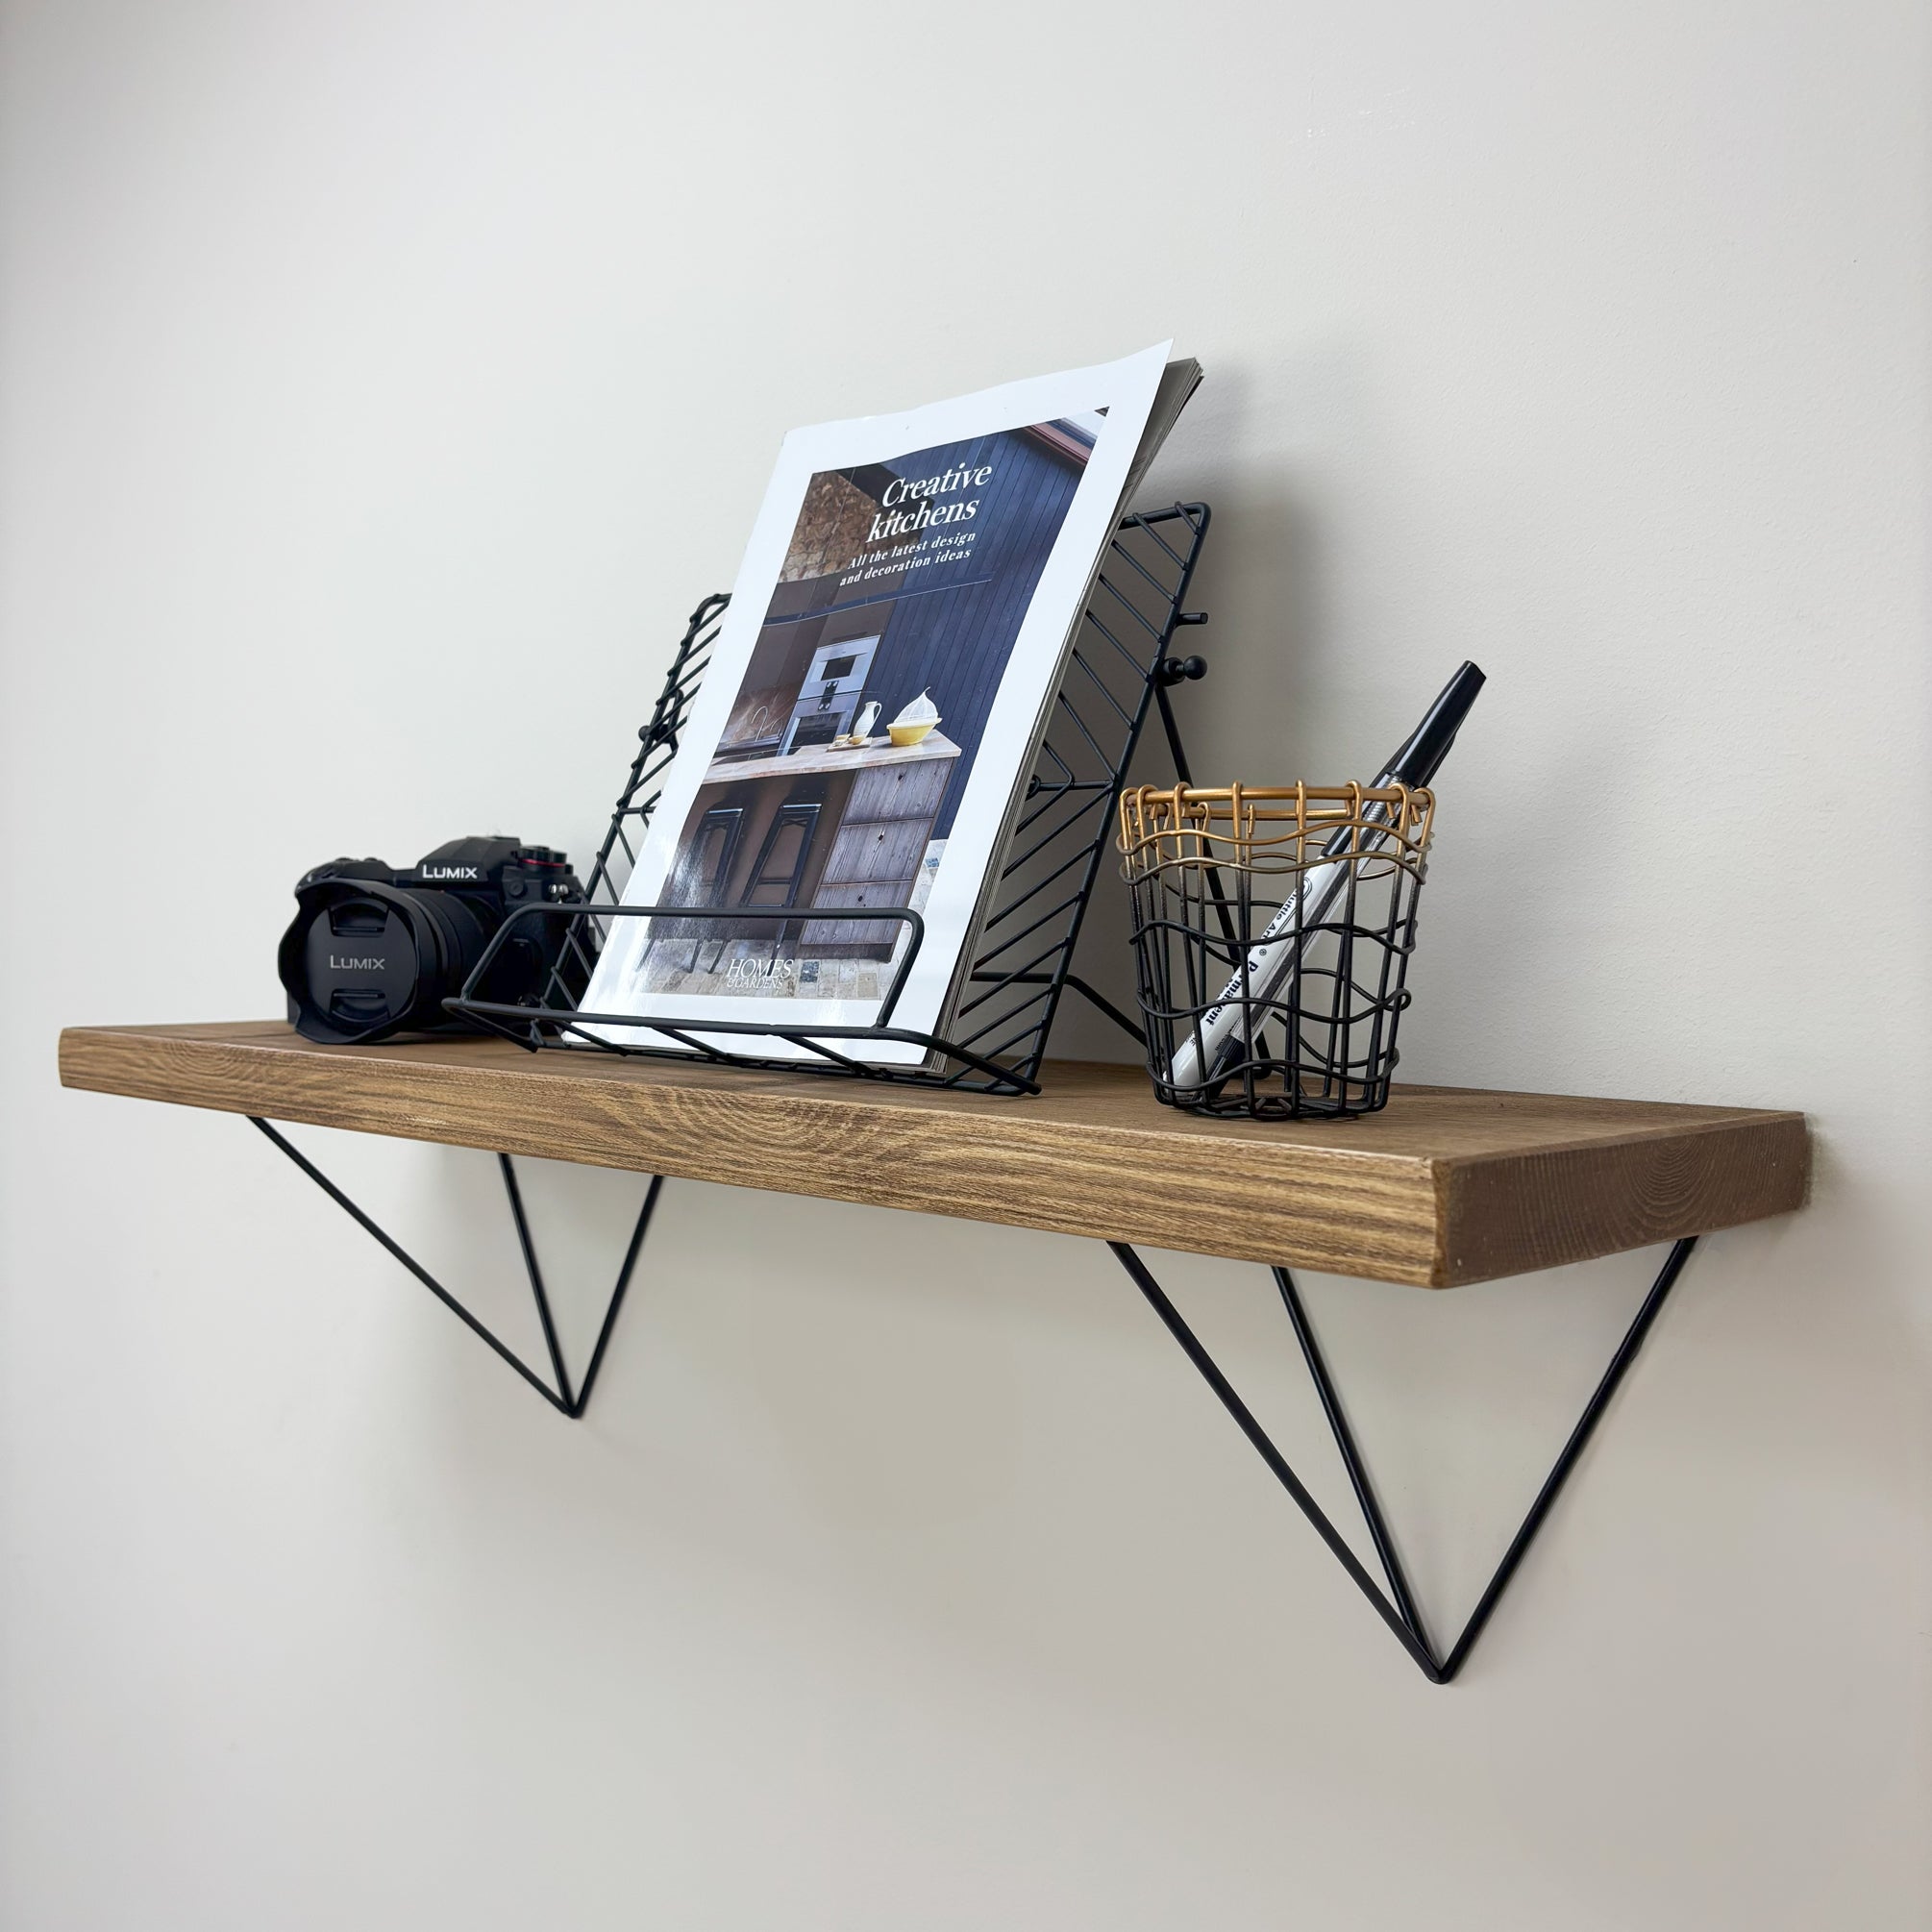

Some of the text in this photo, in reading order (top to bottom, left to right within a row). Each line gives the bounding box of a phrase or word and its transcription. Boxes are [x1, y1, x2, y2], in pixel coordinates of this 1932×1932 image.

[881, 461, 993, 508] Creative
[865, 498, 980, 544] kitchens
[839, 549, 972, 587] and decoration ideas
[847, 533, 976, 569] All the latest design
[422, 863, 478, 879] LUMIX
[330, 954, 385, 970] LUMIX
[726, 958, 794, 978] HOMES
[1205, 960, 1259, 1027] Prmaent
